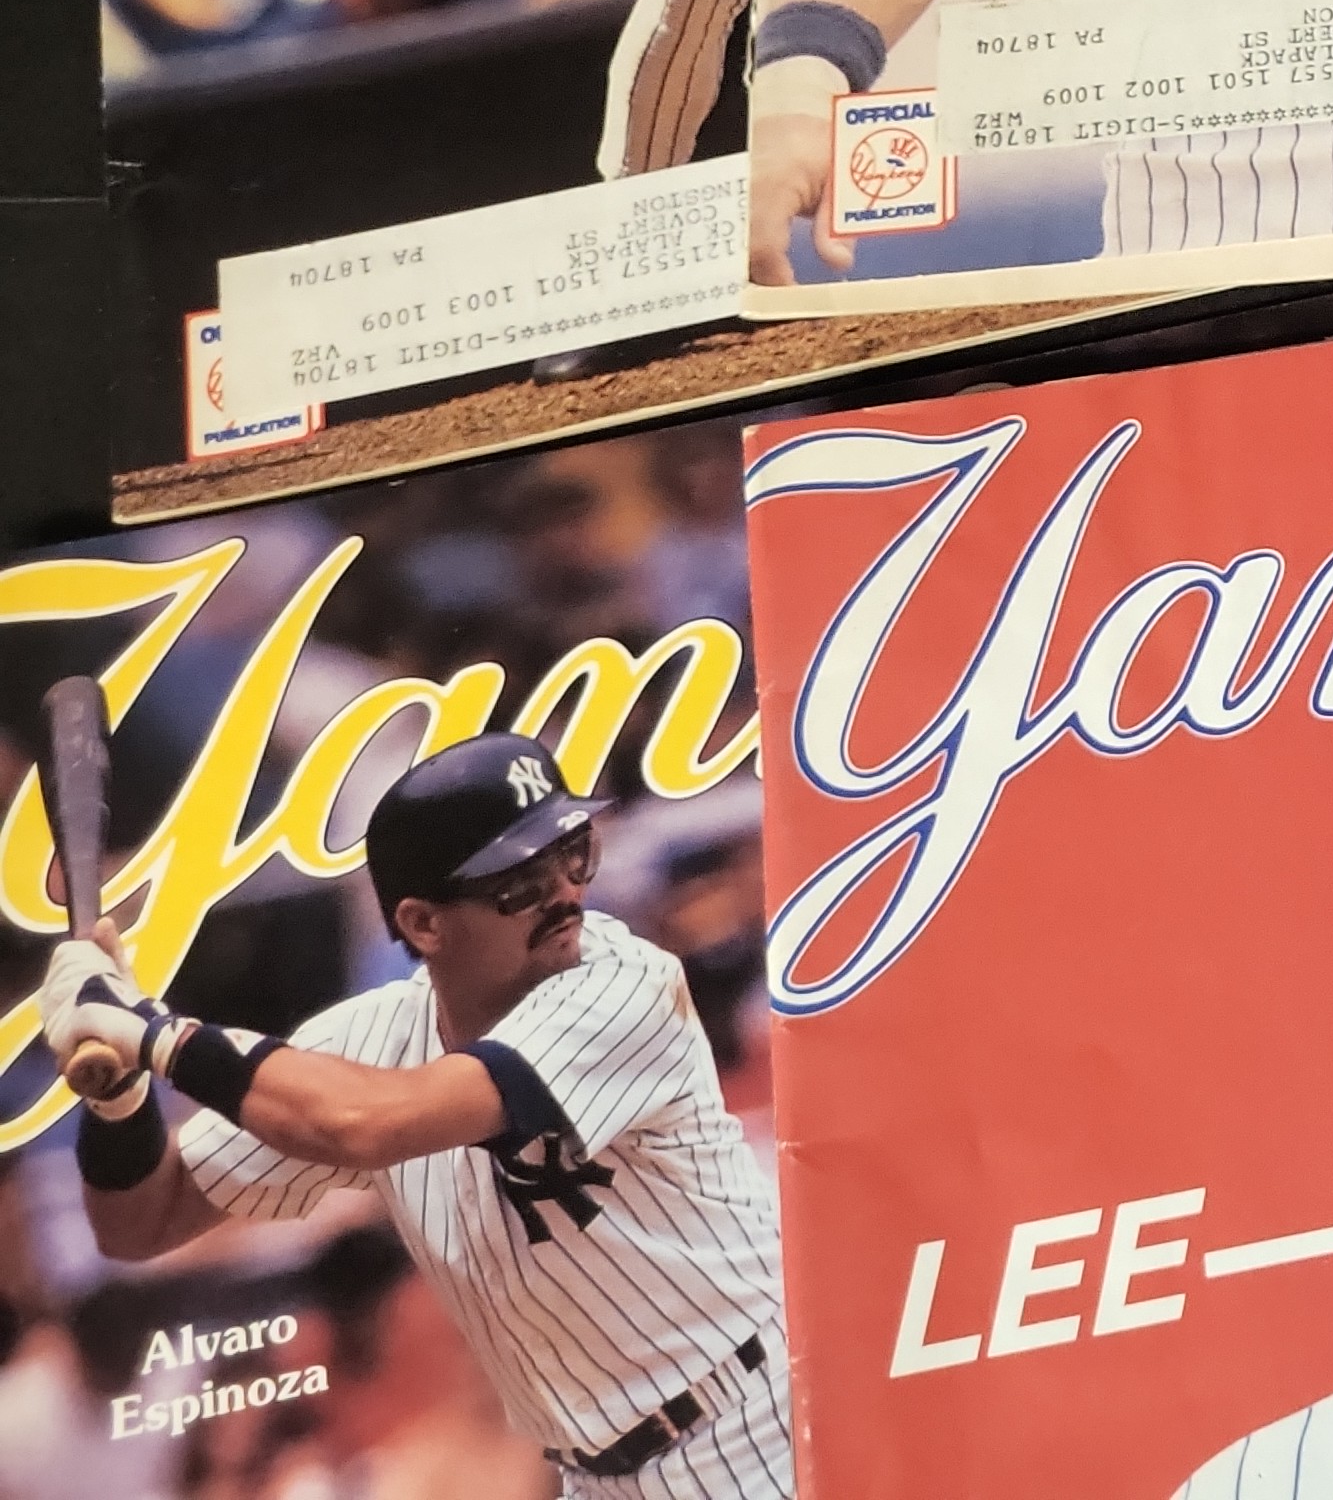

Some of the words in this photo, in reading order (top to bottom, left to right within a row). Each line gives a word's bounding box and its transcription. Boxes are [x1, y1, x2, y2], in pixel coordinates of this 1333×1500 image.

[976, 31, 1057, 56] 18704
[1075, 26, 1106, 47] PA
[1125, 75, 1186, 98] 1002
[1209, 69, 1270, 92] 1501
[1042, 83, 1106, 107] 1009
[844, 100, 936, 127] OFFICIAL
[974, 125, 1055, 150] 18704
[844, 200, 936, 224] PUBLICATION
[393, 245, 426, 266] PA
[289, 255, 374, 287] 18704
[535, 267, 598, 298] 1501
[448, 283, 514, 315] 1003
[362, 302, 427, 334] 1009
[292, 353, 377, 387] 18704
[204, 414, 302, 445] PUBLICATION
[141, 1315, 298, 1375] Alvaro
[111, 1364, 329, 1440] Espinoza
